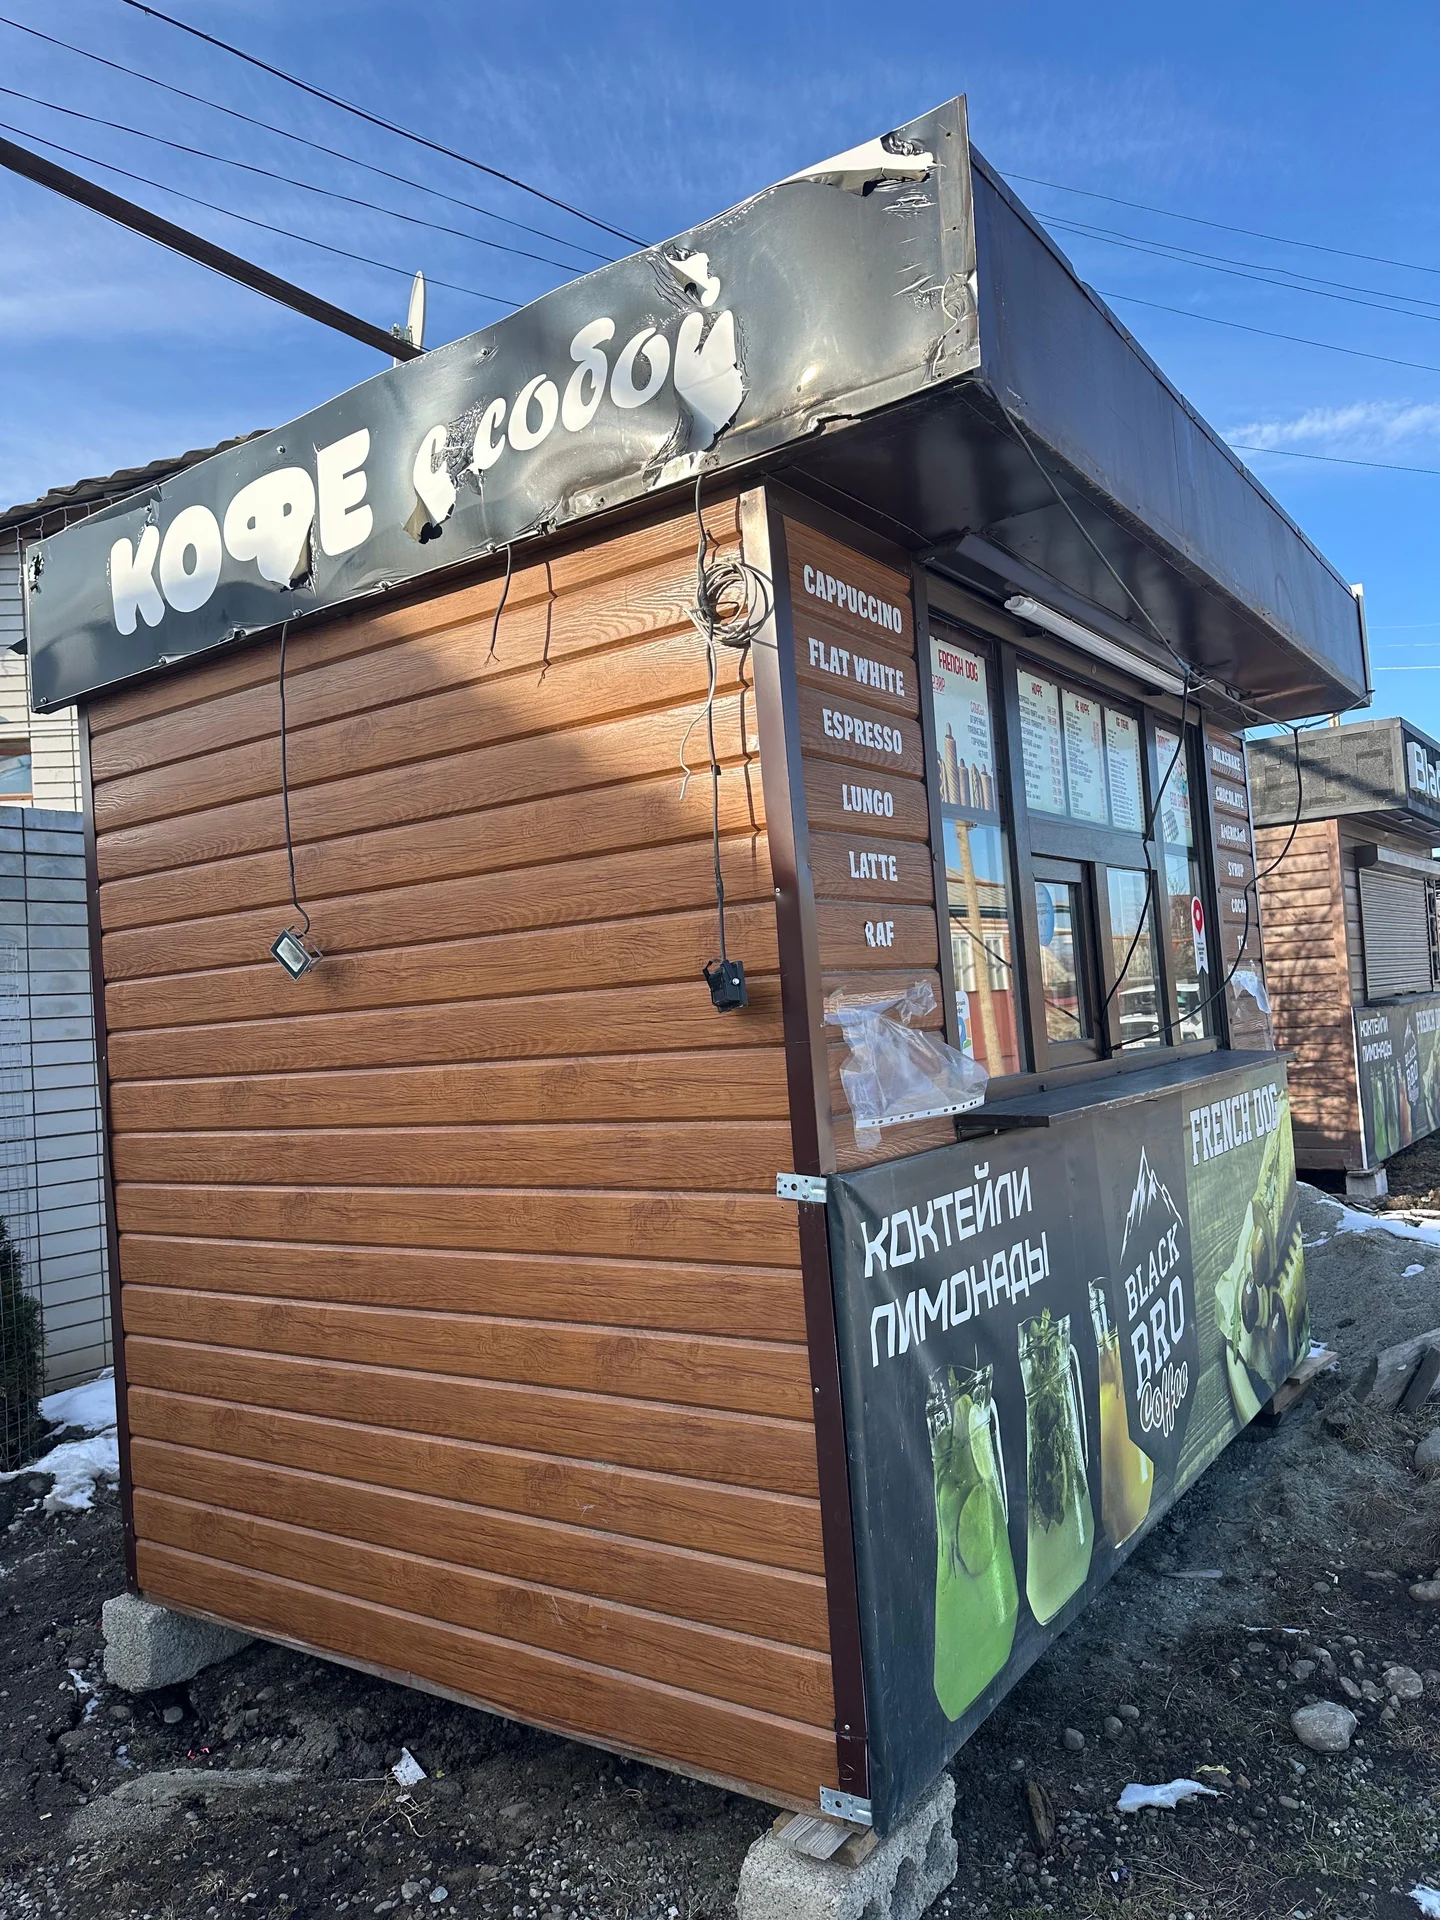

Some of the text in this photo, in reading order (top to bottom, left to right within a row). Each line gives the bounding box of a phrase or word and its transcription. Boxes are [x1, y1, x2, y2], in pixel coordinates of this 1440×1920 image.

[110, 428, 373, 635] КОФЕ
[803, 564, 902, 634] CAPPUCCINO
[808, 637, 905, 696] FLAT WHITE
[938, 648, 979, 682] FRENCH DOG
[822, 708, 902, 755] ESPRESSO
[842, 783, 894, 817] LUNGO
[1215, 785, 1244, 809] CHOCOLATE
[849, 851, 898, 881] LATTE
[864, 920, 894, 947] RAF
[1189, 1082, 1279, 1167] FRENCH DOG
[861, 1162, 1033, 1278] КОКТЕЙЛИ
[869, 1232, 1050, 1368] ЛИМОНАДЫ
[1125, 1222, 1181, 1321] BLACK
[1131, 1275, 1185, 1401] BRO
[1140, 1361, 1189, 1438] Coffee
